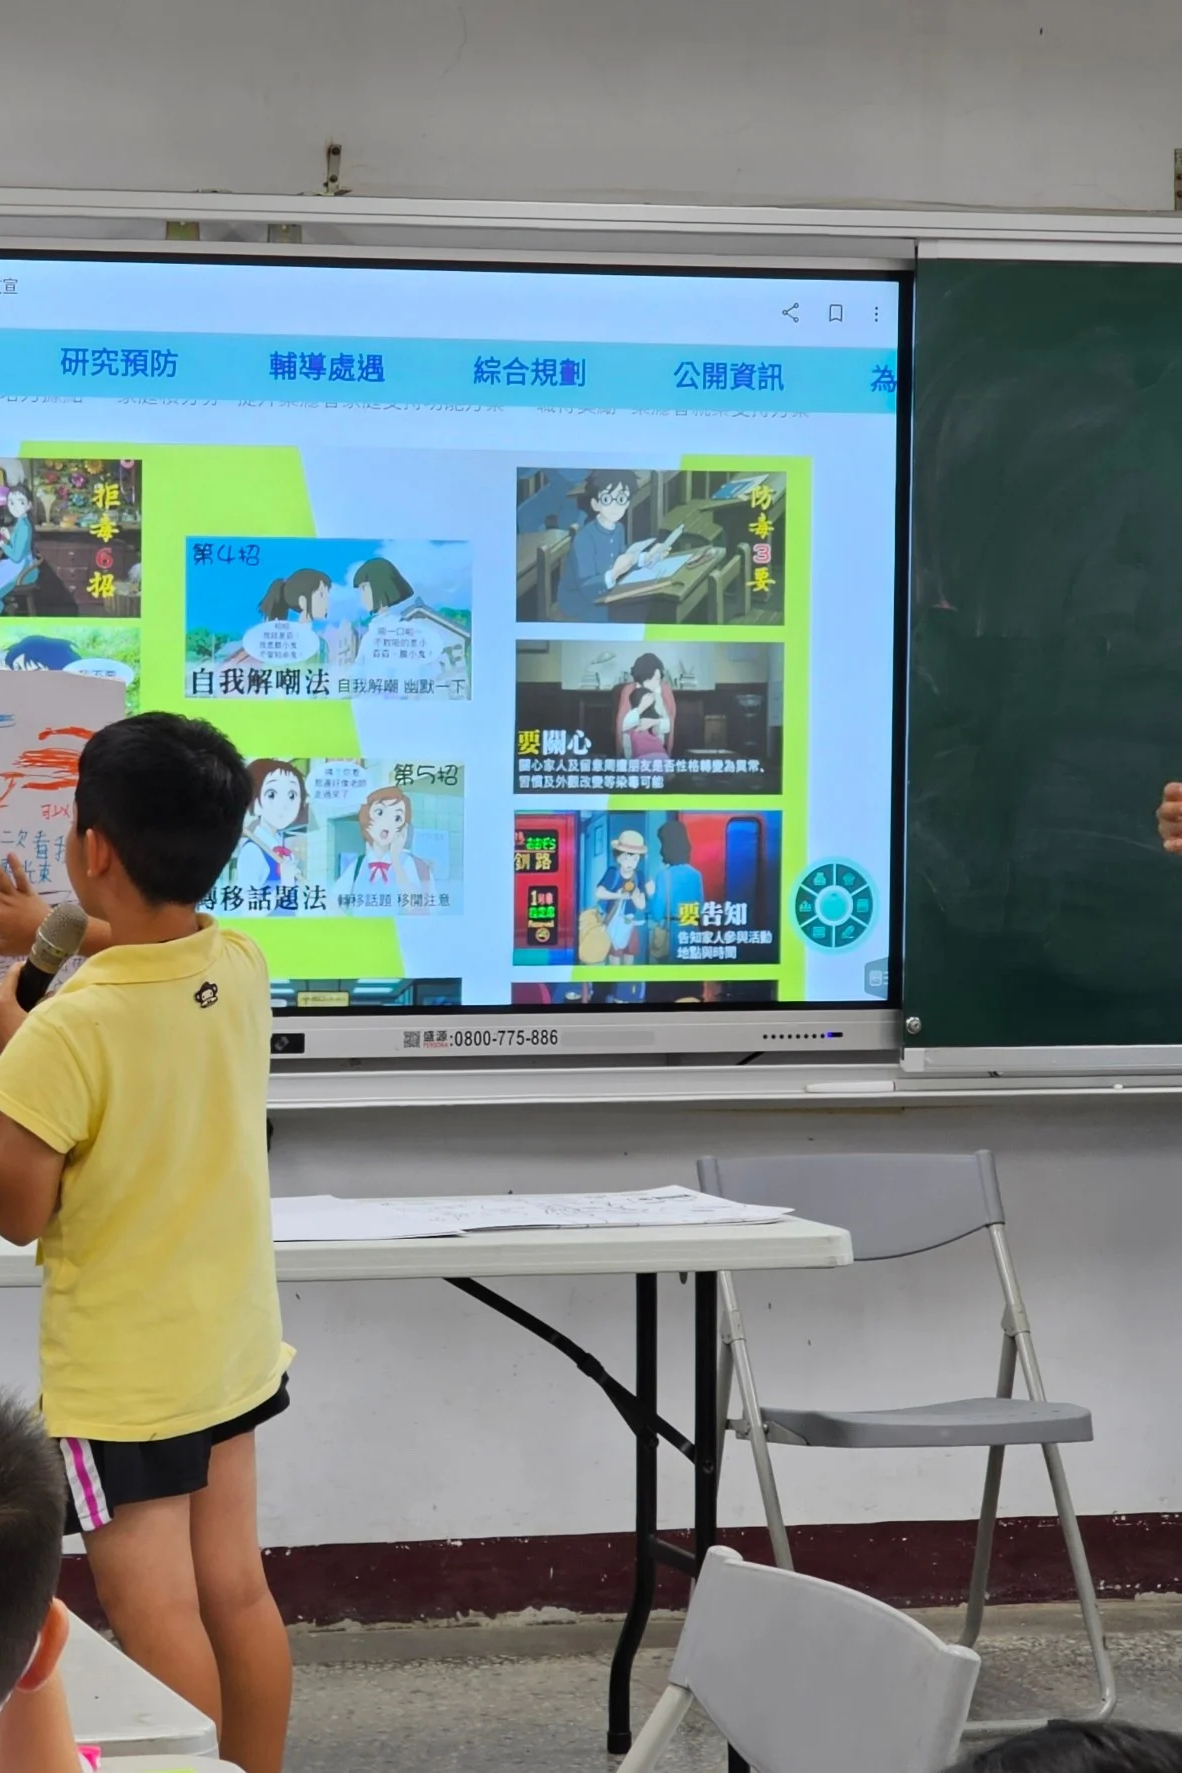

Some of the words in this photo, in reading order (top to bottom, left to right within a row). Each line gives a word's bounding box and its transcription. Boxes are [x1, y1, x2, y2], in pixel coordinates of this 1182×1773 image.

[60, 347, 179, 379] 研究預防
[270, 351, 386, 383] 輔導處遇
[473, 356, 587, 390] 綜合規劃
[673, 360, 785, 392] 公開資訊
[86, 482, 122, 599] 拒毒6招
[745, 485, 776, 593] 防毒3要
[193, 543, 261, 566] 第4招
[191, 667, 331, 697] 自我解嘲法
[337, 678, 399, 695] 自我解嘲
[404, 678, 466, 696] 幽默一下
[517, 729, 592, 757] 要關心
[393, 763, 459, 787] 第5招
[337, 893, 392, 908] 轉移話題
[397, 893, 451, 908] 移開注意
[678, 900, 748, 928] 要告知
[677, 930, 773, 946] 告知家人參與活動
[676, 946, 738, 960] 地點與時間
